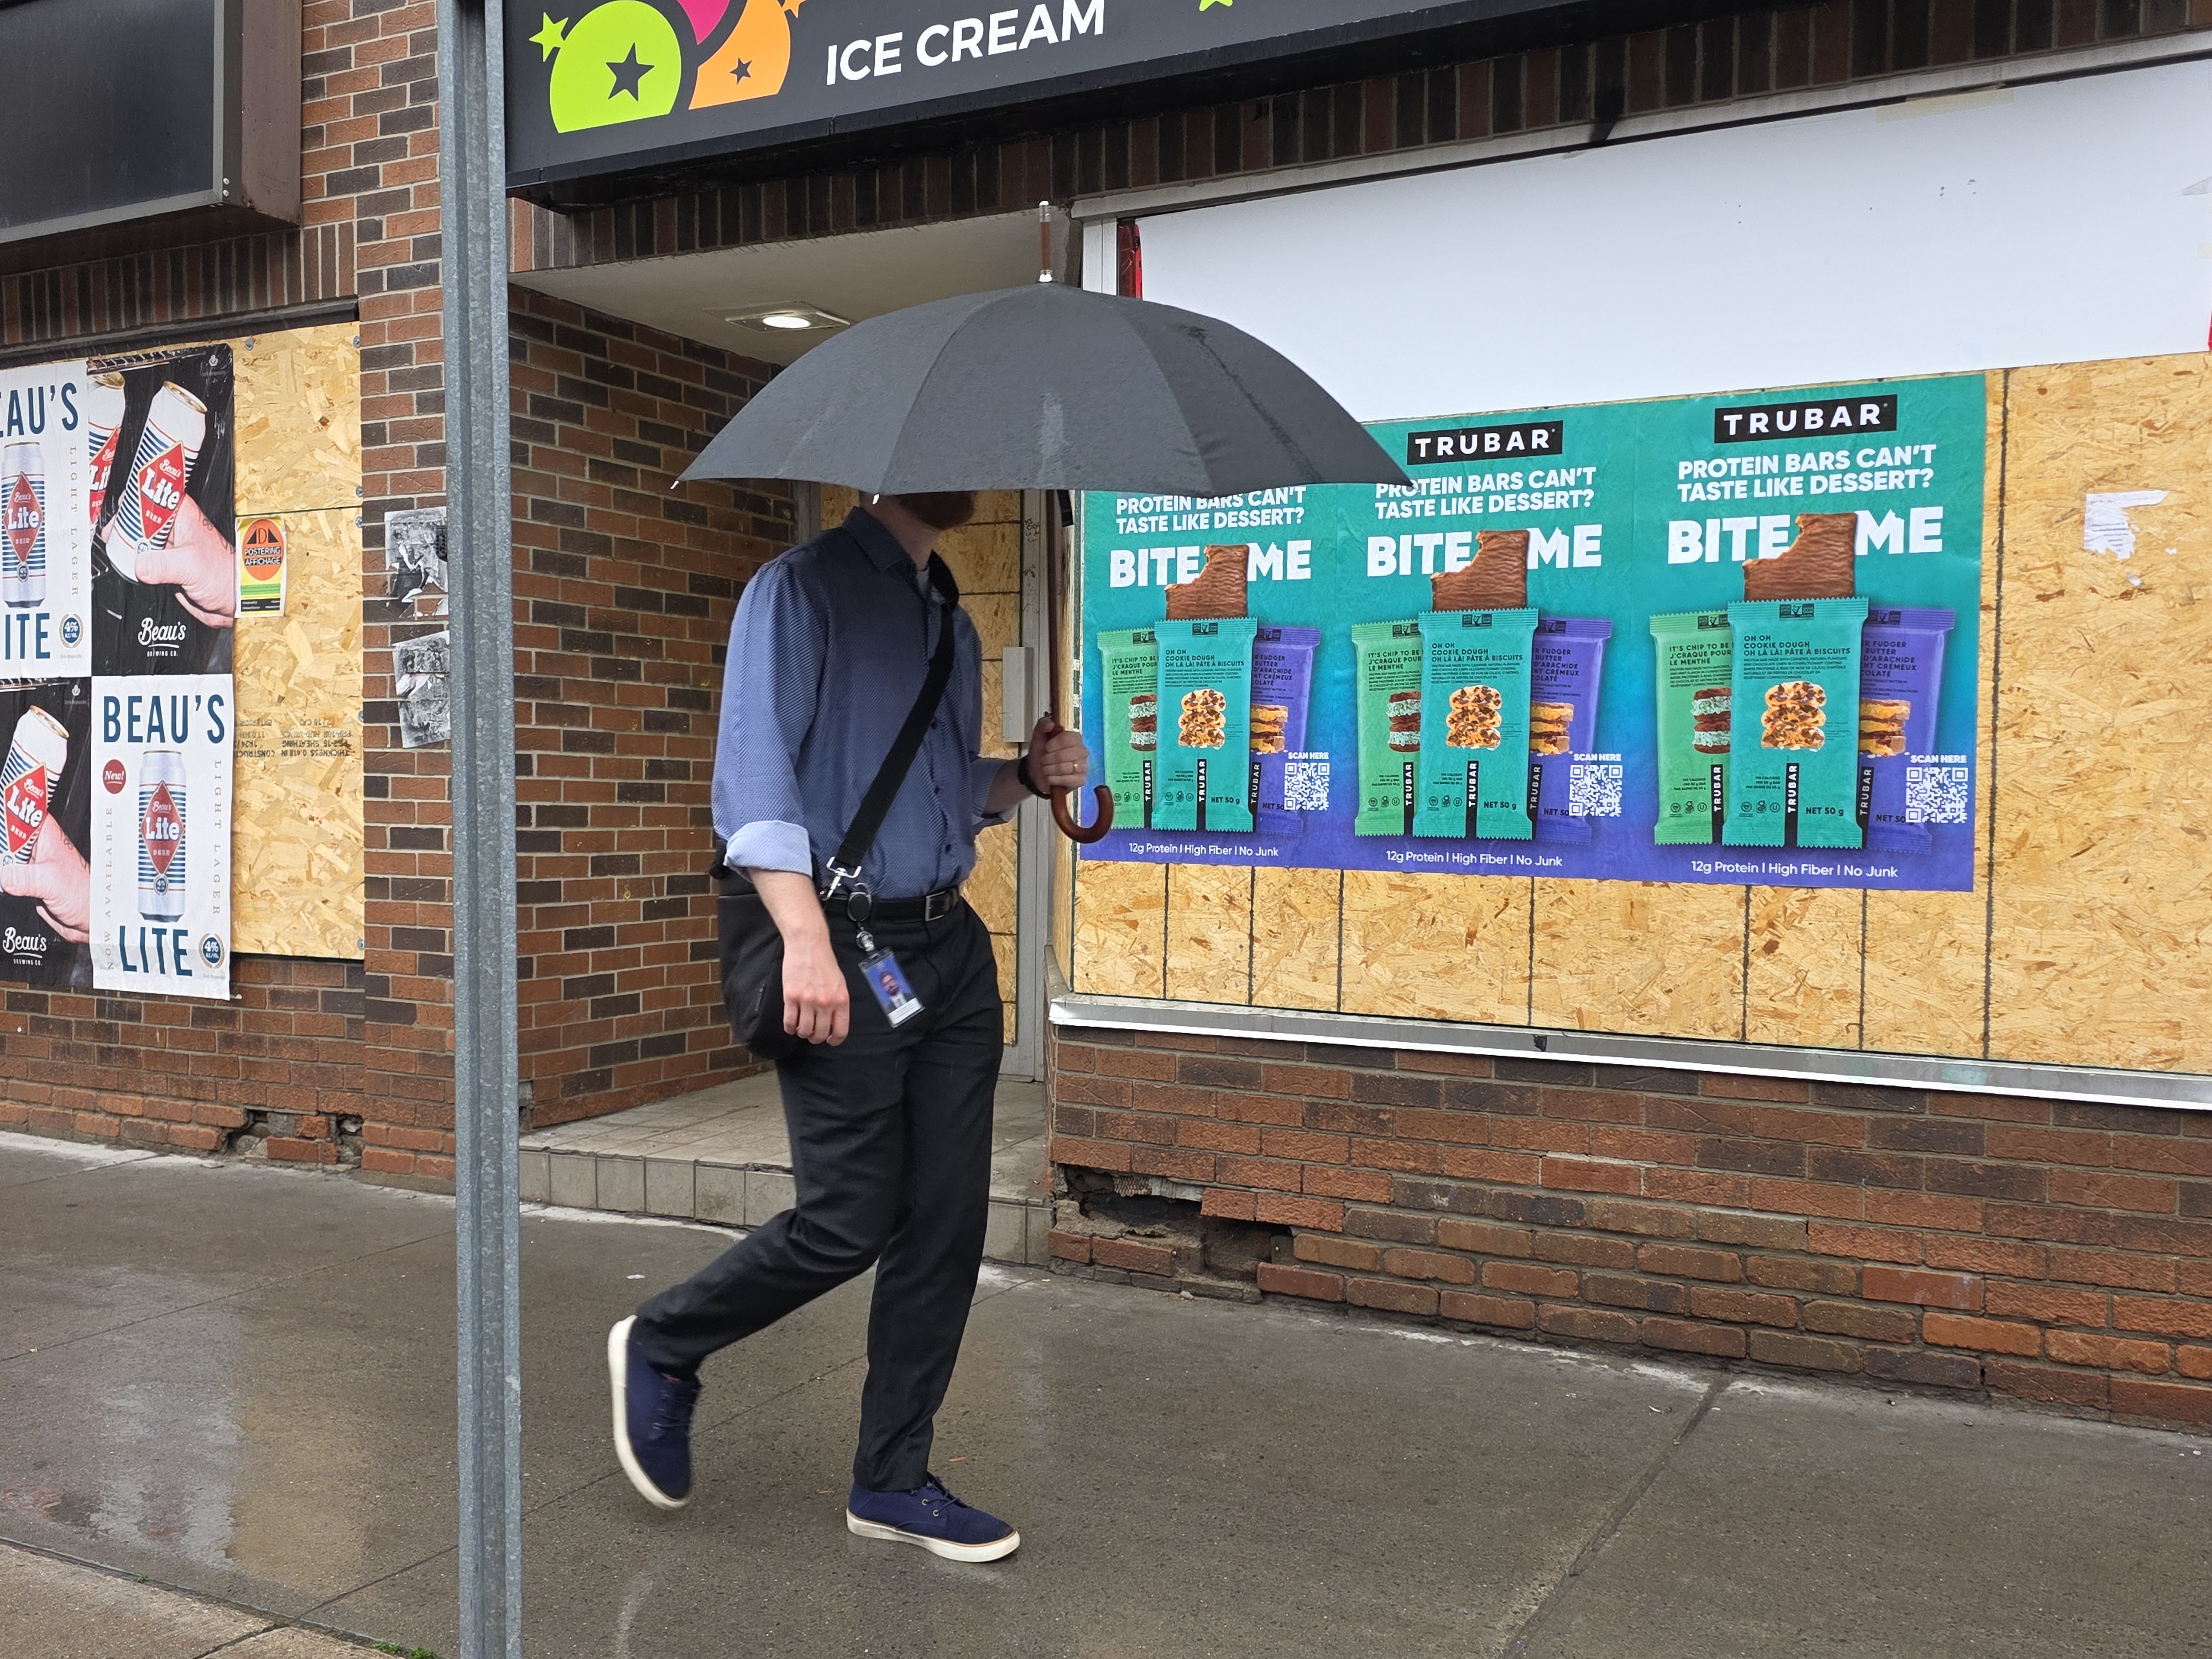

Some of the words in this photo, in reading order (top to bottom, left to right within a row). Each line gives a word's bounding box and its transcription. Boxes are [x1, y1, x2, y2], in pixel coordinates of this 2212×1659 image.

[826, 32, 903, 85] ICE
[916, 0, 1105, 66] CREAM
[0, 383, 78, 437] AU'S
[1723, 404, 1880, 436] TRUBAR
[1415, 429, 1550, 457] TRUBAR
[159, 459, 181, 478] Beau's
[1678, 455, 1778, 479] PROTEIN
[1785, 451, 1849, 473] BARS
[1856, 444, 1936, 467] CAN'T
[142, 467, 180, 510] Lite
[1375, 476, 1462, 498] PROTEIN
[1468, 471, 1523, 492] BARS
[1528, 467, 1596, 489] CAN'T
[1678, 481, 1747, 502] TASTE
[1754, 477, 1803, 497] LIKE
[1809, 468, 1934, 494] DESSERT?
[1117, 496, 1191, 515] PROTEIN
[1248, 487, 1306, 507] CAN'T
[1375, 499, 1436, 520] TASTE
[1441, 496, 1484, 515] LIKE
[1489, 489, 1594, 513] DESSERT?
[8, 507, 39, 529] Lite
[1116, 515, 1168, 534] TASTE
[1172, 514, 1209, 530] LIKE
[1213, 507, 1305, 529] DESSERT?
[1367, 531, 1472, 577] BITE
[1527, 524, 1603, 570] ME
[1668, 514, 1791, 564] BITE
[1855, 506, 1943, 555] ME
[244, 546, 280, 556] POSTERING
[246, 557, 280, 566] AFFICHAGE
[1110, 546, 1200, 588] BITE
[1246, 539, 1312, 582] ME
[5, 612, 50, 659] ITE
[64, 622, 78, 632] 4%
[138, 617, 186, 646] Beau's
[1877, 662, 1917, 671] CRÉMEUX
[103, 693, 225, 744] BEAU'S
[1599, 753, 1621, 761] HERE
[1940, 755, 1967, 763] HERE
[104, 770, 124, 780] New!
[1251, 764, 1260, 804] TRUBAR
[1530, 766, 1540, 809] TRUBAR
[1788, 765, 1797, 813] TRUBAR
[7, 785, 43, 827] Lite
[1860, 769, 1872, 815] TRUBAR
[145, 817, 179, 840] Lite
[1129, 843, 1144, 854] 12g
[1146, 843, 1178, 854] Protein
[1185, 844, 1206, 857] High
[1209, 846, 1232, 855] Fiber
[1239, 847, 1253, 856] No
[1255, 847, 1279, 857] Junk
[1386, 851, 1404, 863] 12g
[1406, 852, 1443, 863] Protein
[1452, 853, 1477, 865] High
[1480, 854, 1507, 864] Fiber
[1516, 855, 1532, 865] No
[1535, 855, 1562, 867] Junk
[212, 844, 221, 914] LAGER
[1691, 860, 1712, 874] 12g
[1715, 862, 1759, 873] Protein
[1768, 863, 1797, 877] High
[1801, 864, 1834, 875] Fiber
[1844, 865, 1863, 877] No
[1866, 865, 1898, 878] Junk
[3, 927, 47, 953] Beau's
[104, 931, 113, 970] NOW
[119, 925, 192, 977] LITE
[204, 941, 218, 952] 4%
